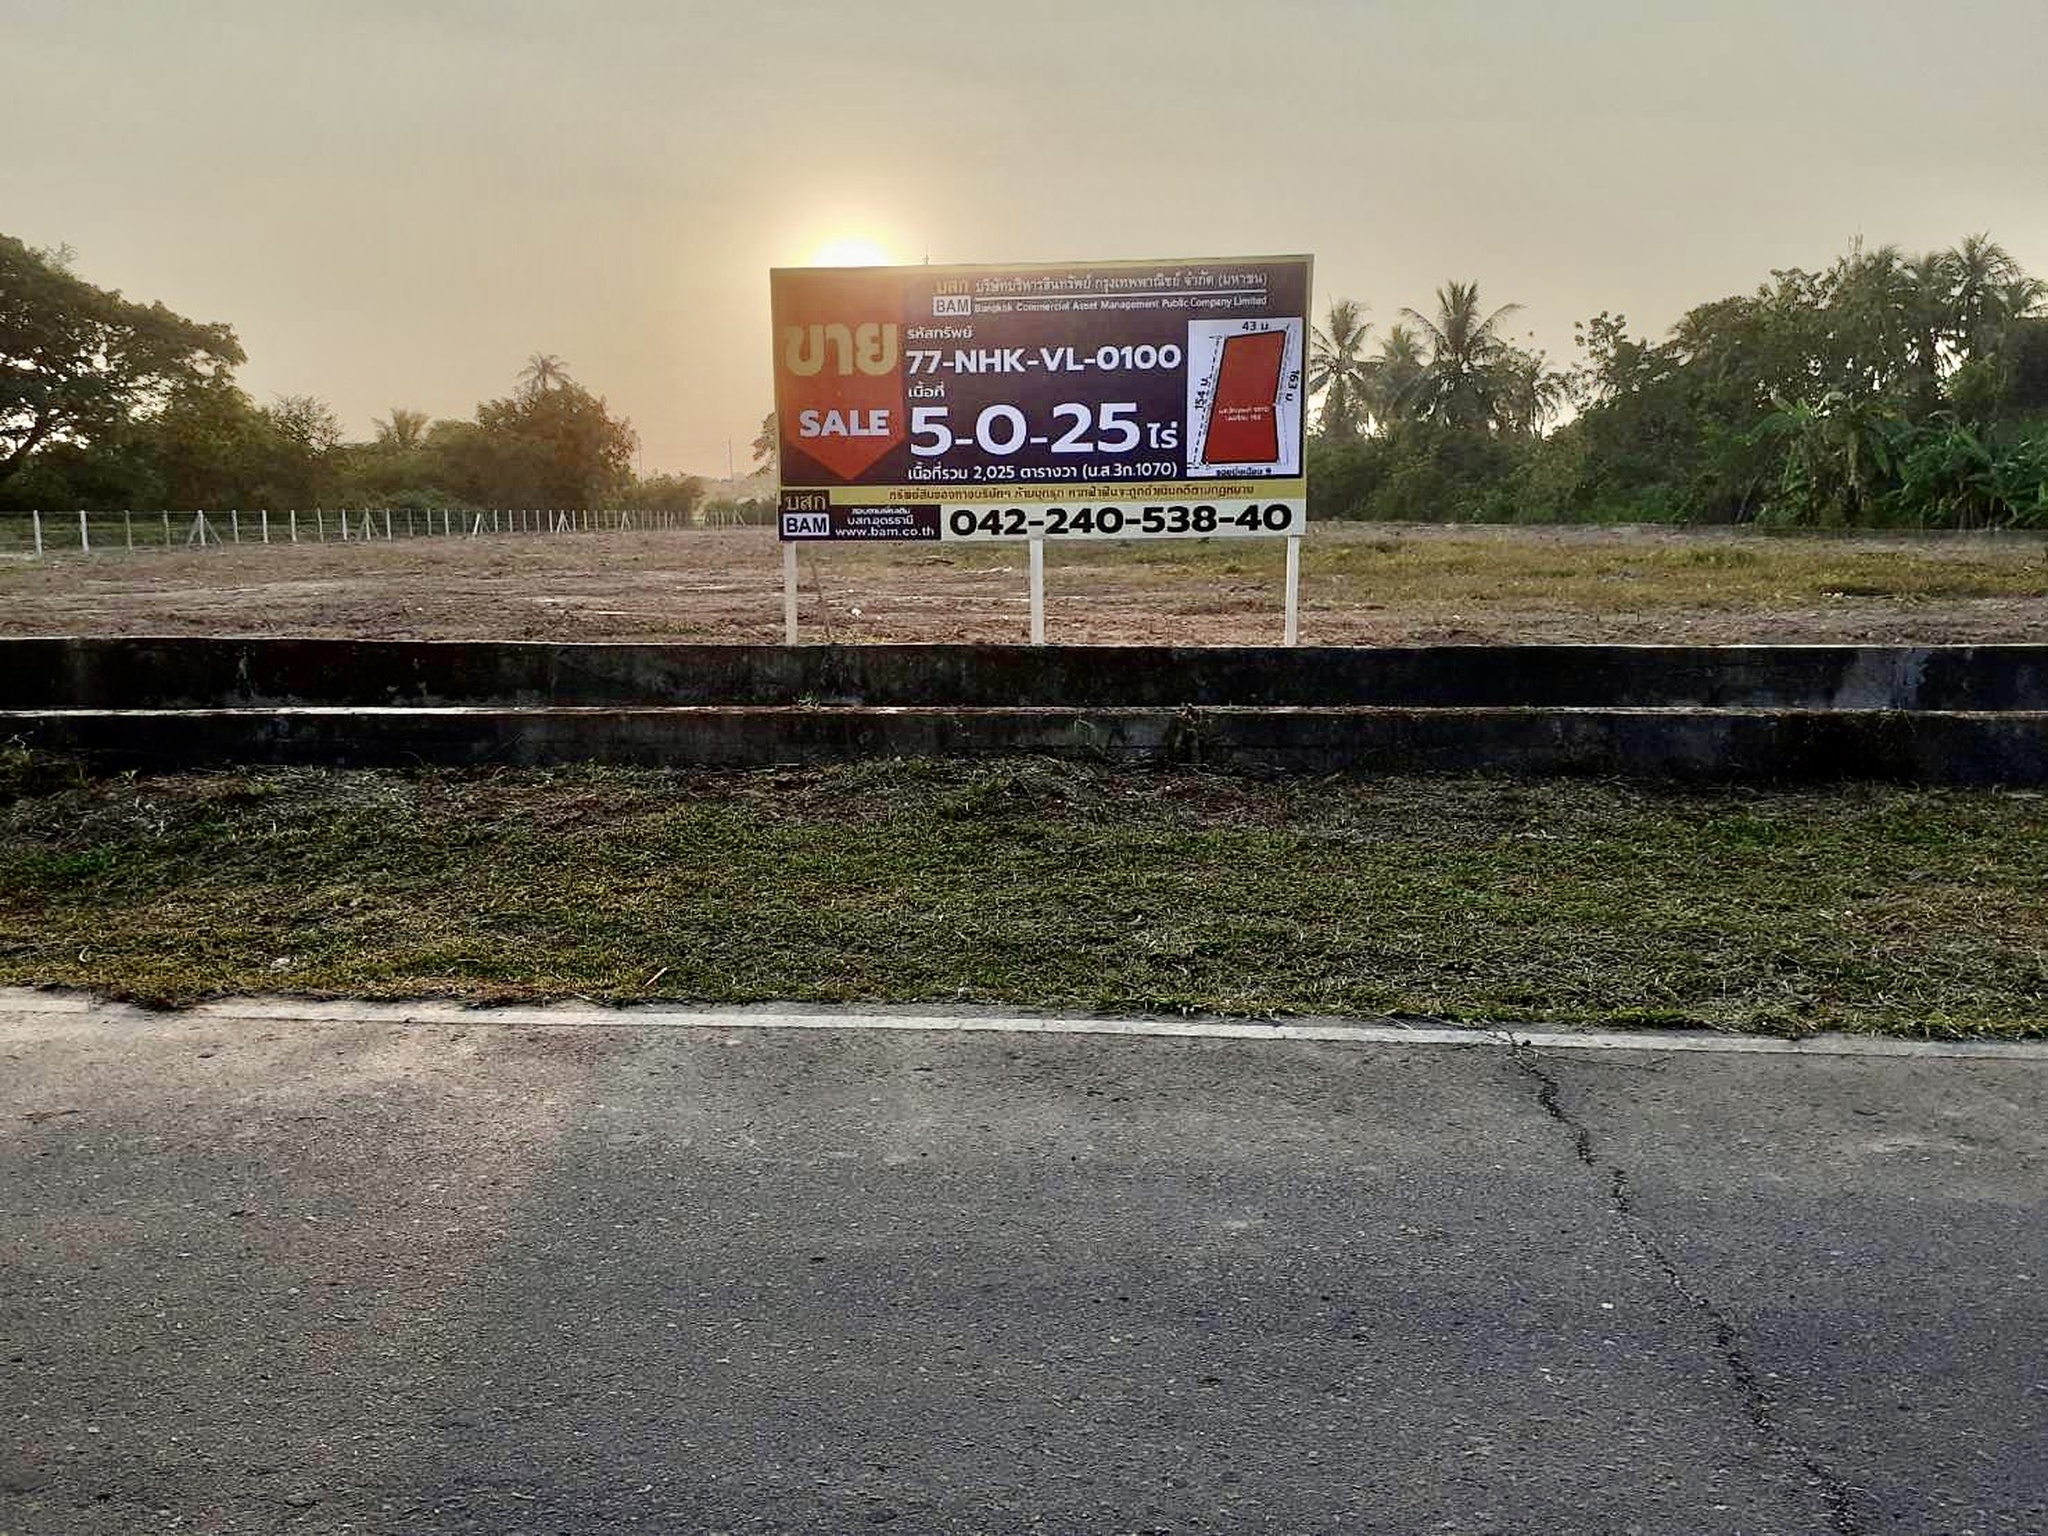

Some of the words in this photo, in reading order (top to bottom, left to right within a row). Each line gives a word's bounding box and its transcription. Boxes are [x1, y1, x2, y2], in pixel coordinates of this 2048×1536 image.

[936, 299, 970, 313] BAM
[1100, 298, 1158, 310] Management
[1162, 297, 1187, 308] Public
[1190, 296, 1232, 309] Company
[1233, 294, 1267, 306] Limited
[907, 326, 973, 339] รหัสทรัพย์
[1242, 321, 1256, 331] 43
[785, 322, 898, 377] ขาย
[906, 344, 1182, 374] 77-NHK-VL-0100
[1289, 370, 1300, 390] 163
[908, 382, 945, 398] เนื้อที่
[1194, 391, 1206, 410] 154
[799, 409, 891, 438] SALE
[910, 402, 1141, 455] 5-0-25
[1147, 421, 1179, 449] ไร่
[908, 461, 968, 480] เนื้อที่รวม
[973, 466, 1015, 481] 2,025
[1020, 466, 1077, 478] ตารางวา
[783, 495, 826, 510] บสก
[786, 517, 828, 533] BAM
[949, 504, 1292, 536] 042-240-538-40
[835, 526, 935, 536] www.bam.co.th
